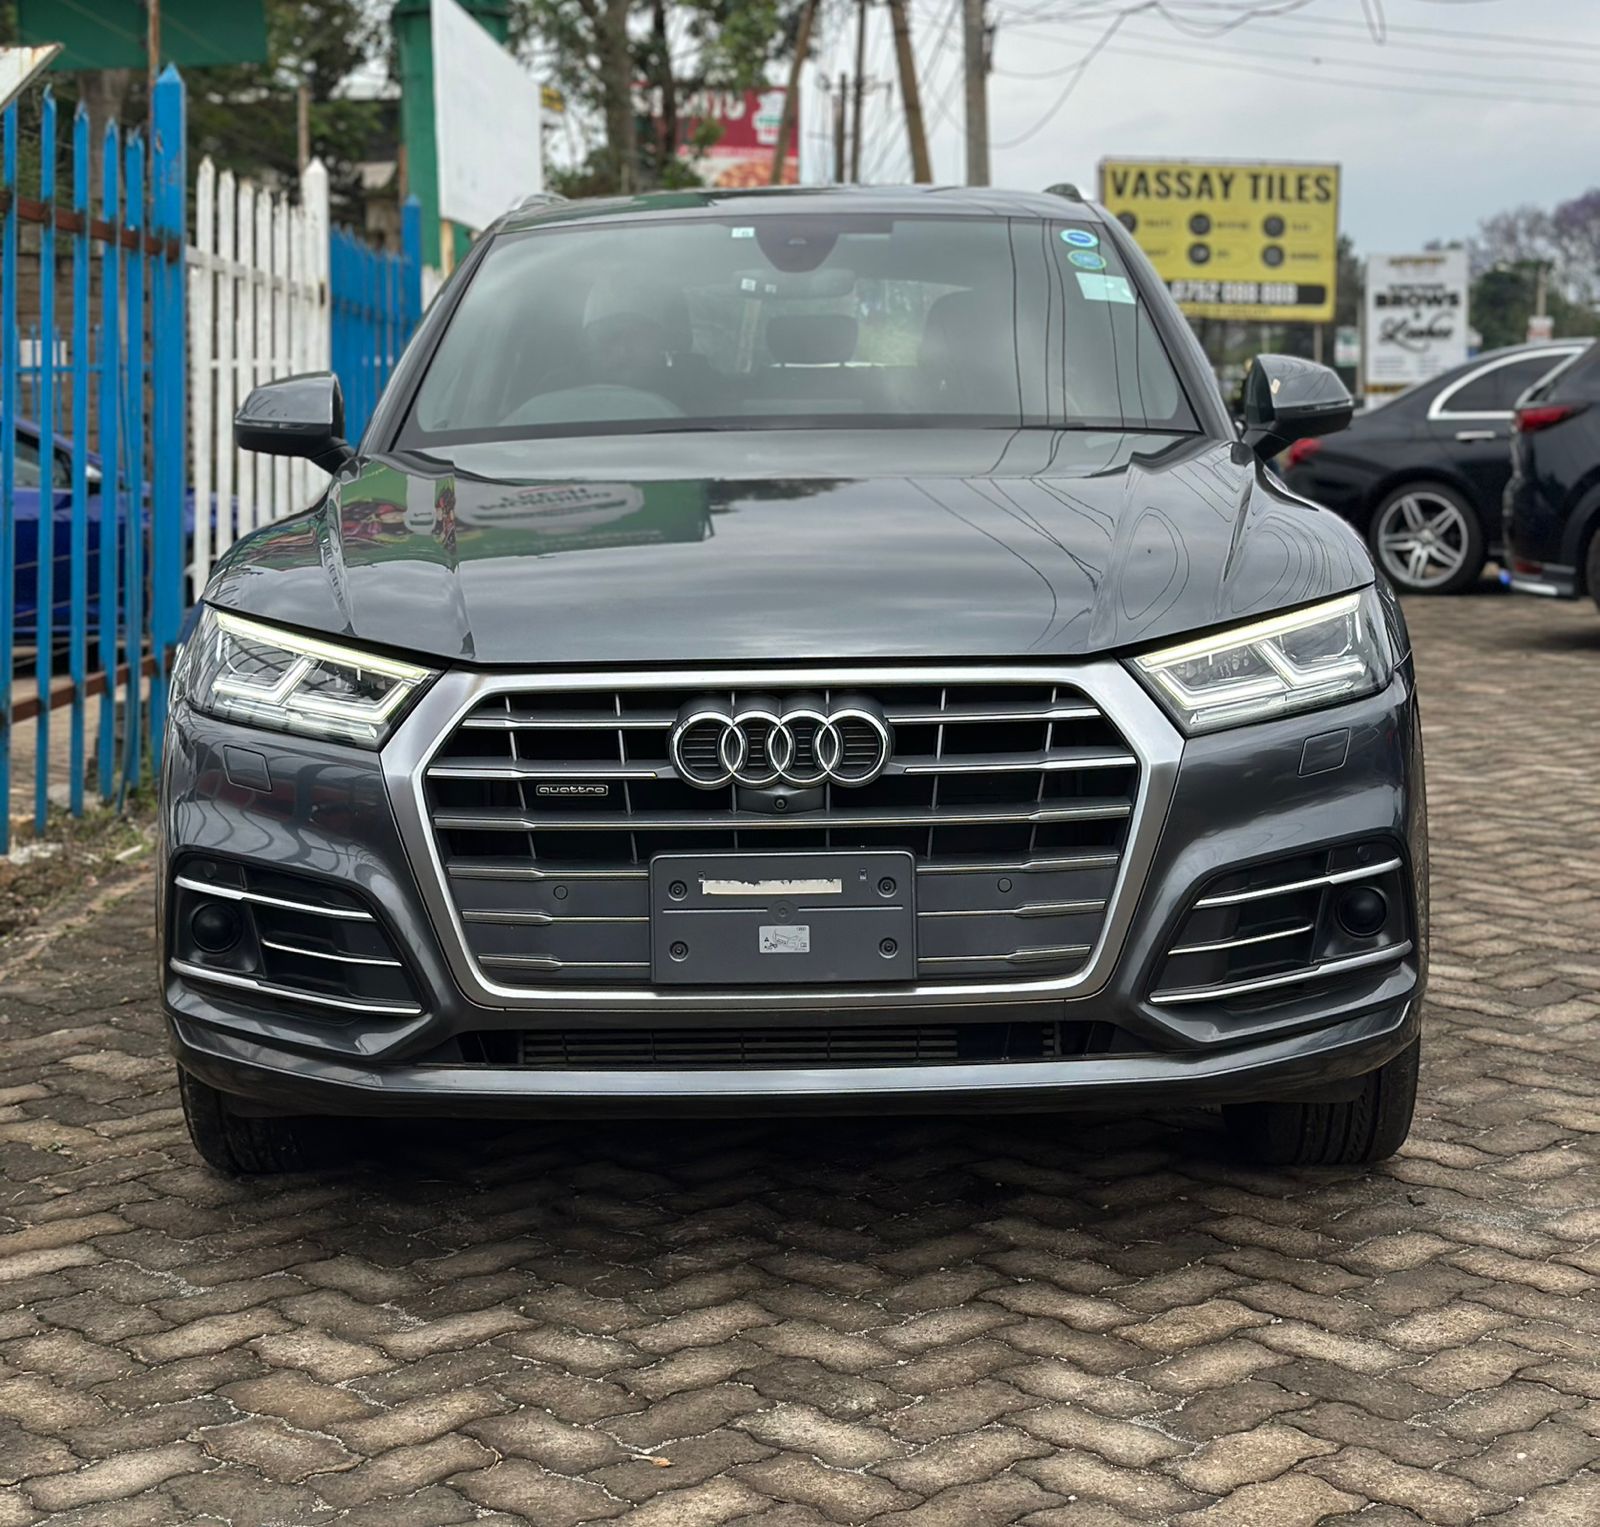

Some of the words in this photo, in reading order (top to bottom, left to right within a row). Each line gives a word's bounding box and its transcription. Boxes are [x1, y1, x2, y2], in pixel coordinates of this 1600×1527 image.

[1112, 169, 1235, 200] VASSAY
[1249, 174, 1331, 203] TILES
[539, 786, 605, 794] quattro
